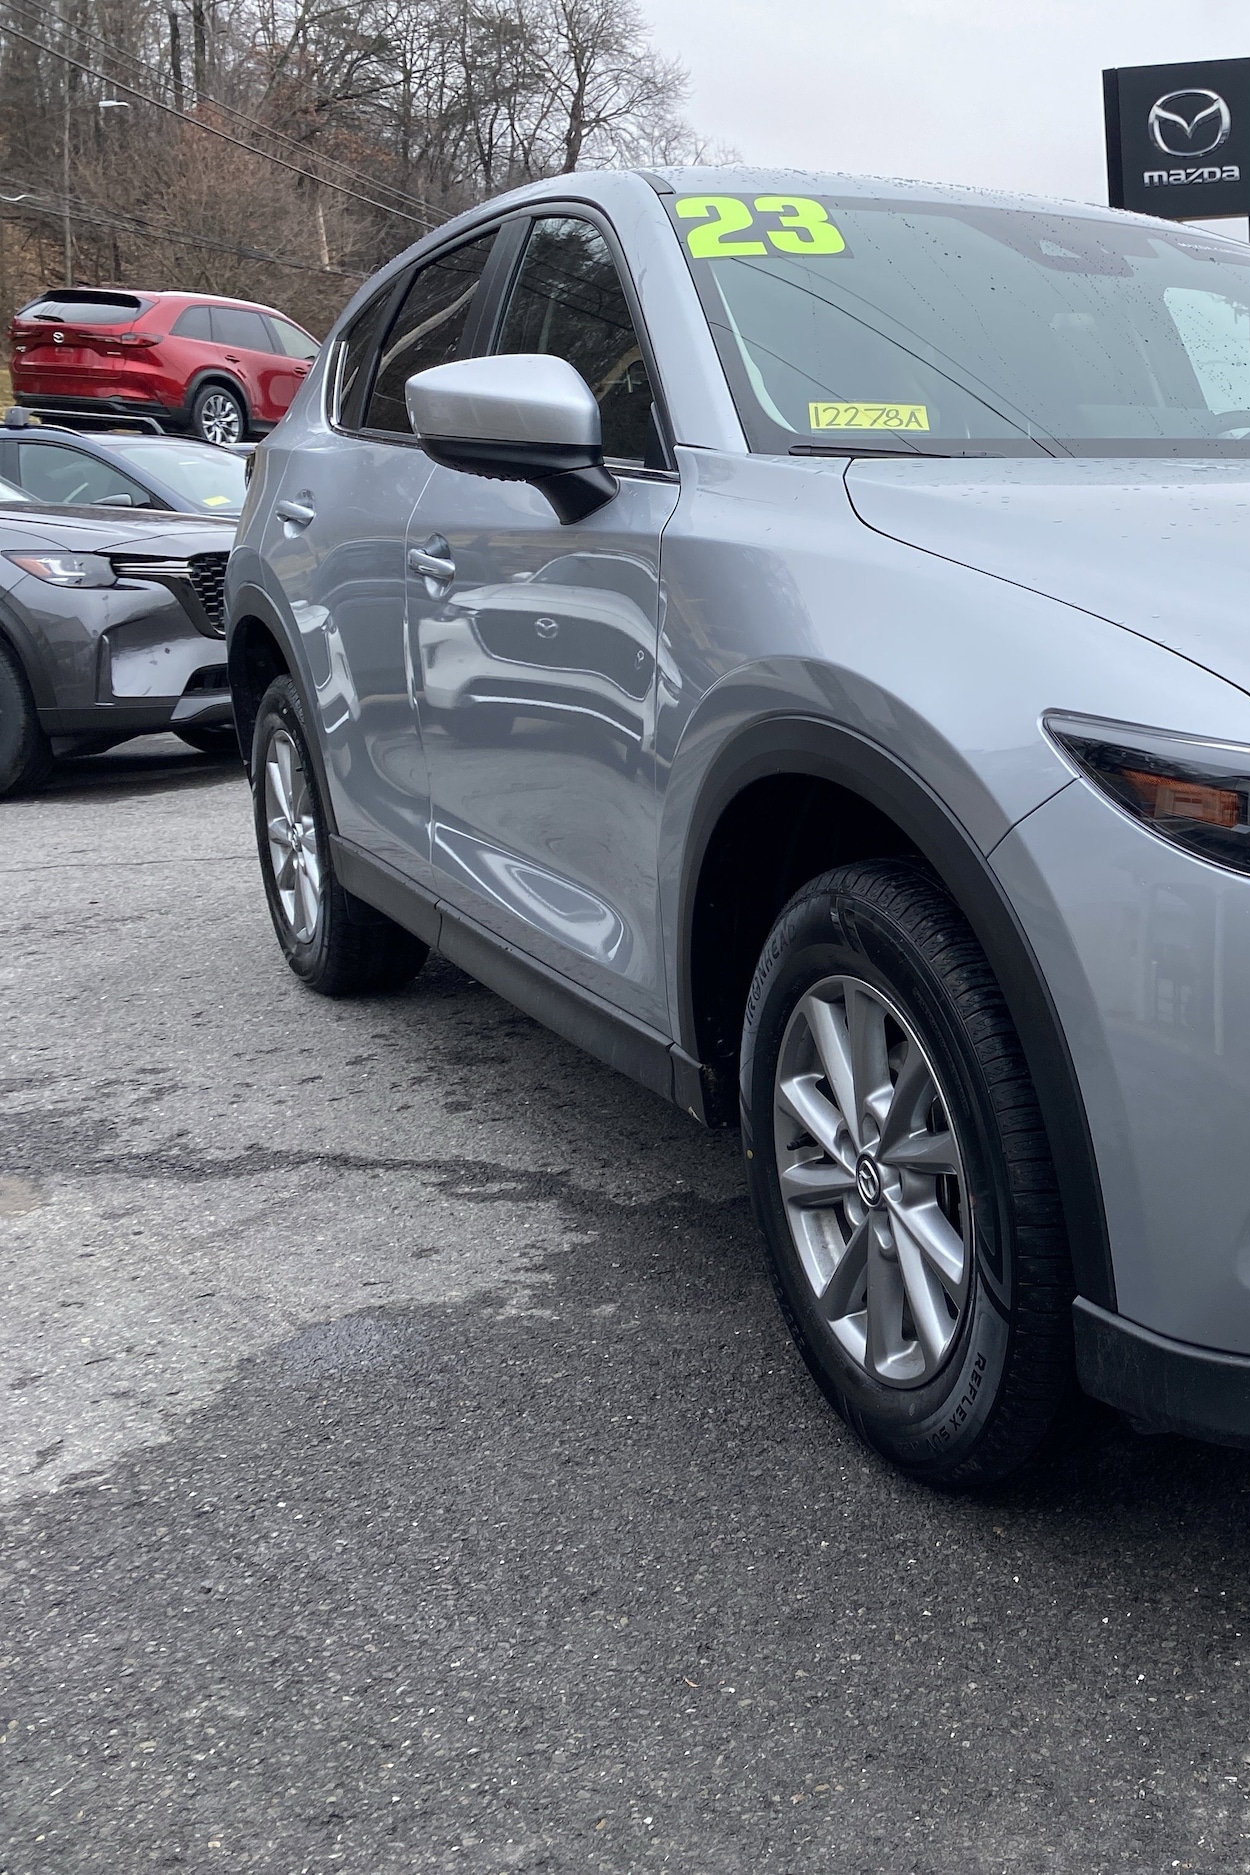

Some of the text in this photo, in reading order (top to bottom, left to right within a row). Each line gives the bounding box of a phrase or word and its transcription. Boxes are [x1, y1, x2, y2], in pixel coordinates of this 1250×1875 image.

[1143, 165, 1240, 188] mazda
[675, 196, 846, 258] 23
[814, 406, 924, 428] 12278A
[949, 1352, 987, 1431] REFLEX
